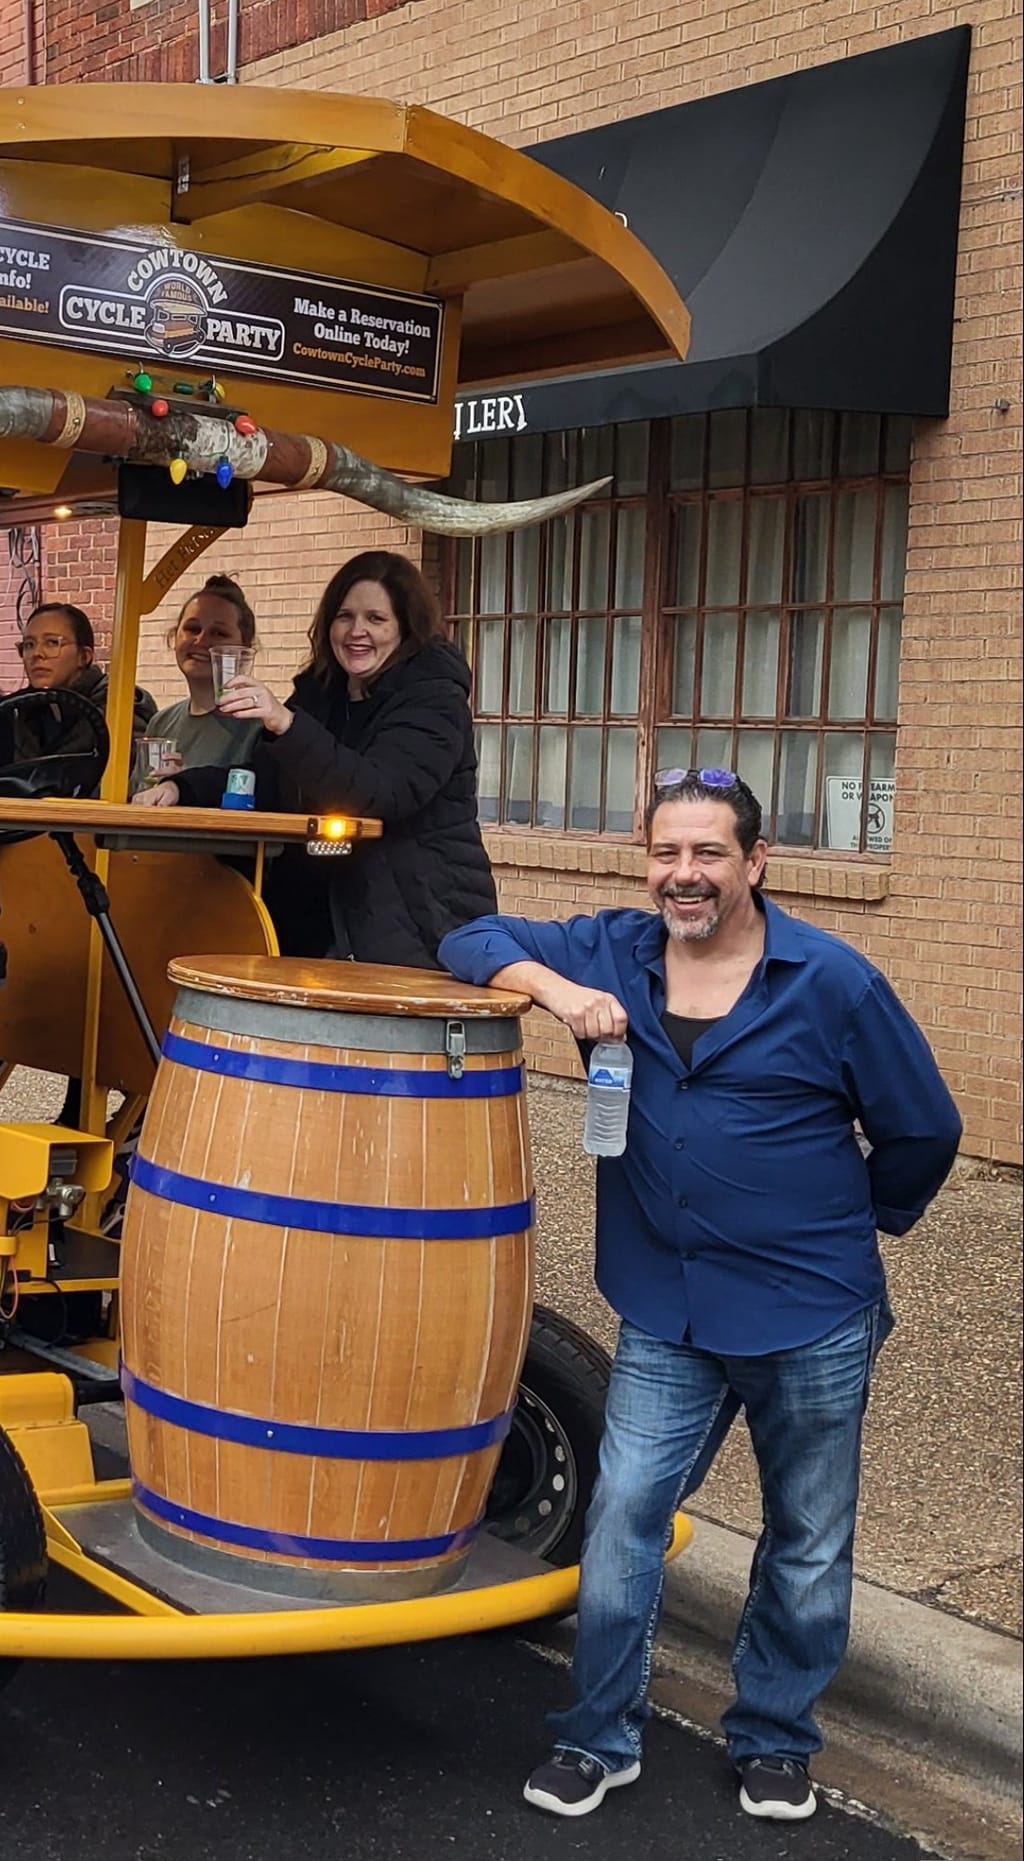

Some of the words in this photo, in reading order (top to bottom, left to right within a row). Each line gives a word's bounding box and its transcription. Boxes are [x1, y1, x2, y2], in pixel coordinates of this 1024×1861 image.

[127, 249, 228, 305] COWTOWN
[164, 282, 192, 294] WORLD
[66, 296, 146, 329] CYCLE
[293, 297, 335, 320] Make
[338, 310, 347, 322] a
[350, 308, 432, 338] Reservation
[206, 318, 281, 351] PARTY
[314, 322, 361, 345] Online
[364, 332, 410, 357] Today!
[292, 342, 426, 378] CowtownCycleParty.com
[842, 782, 856, 790] NO
[842, 791, 855, 800] OR
